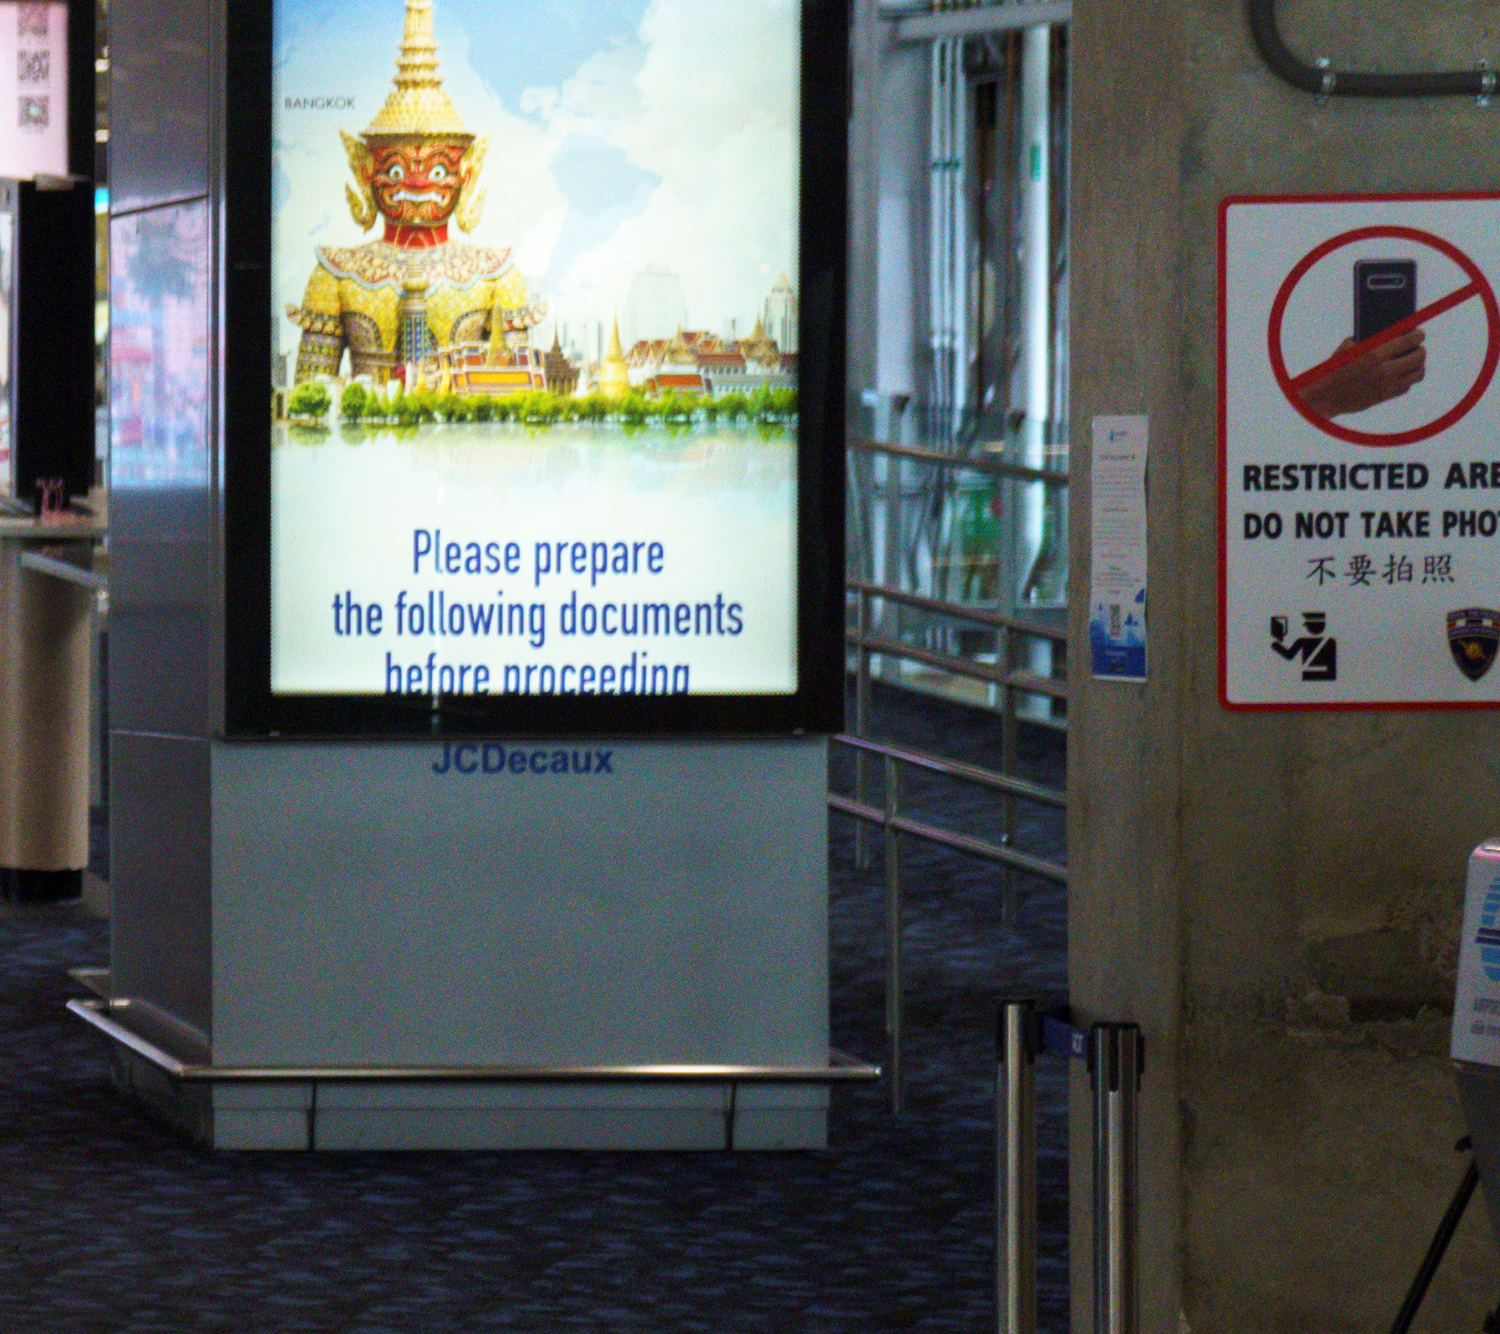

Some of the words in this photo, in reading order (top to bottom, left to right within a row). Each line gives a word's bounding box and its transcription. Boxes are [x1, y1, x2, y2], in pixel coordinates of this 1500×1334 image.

[284, 95, 355, 110] BANGKOK
[1243, 462, 1430, 492] RESTRICTED
[1243, 511, 1283, 540] DO
[1295, 511, 1349, 539] NOT
[1360, 510, 1430, 538] TAKE
[1442, 509, 1500, 538] PHO
[412, 528, 521, 576] Please
[534, 541, 665, 588] prepare
[1307, 553, 1456, 588] 不要拍照
[332, 590, 383, 637] the
[395, 590, 546, 649] following
[559, 590, 744, 637] documents
[384, 651, 490, 694] before
[431, 744, 615, 775] JCDecaux
